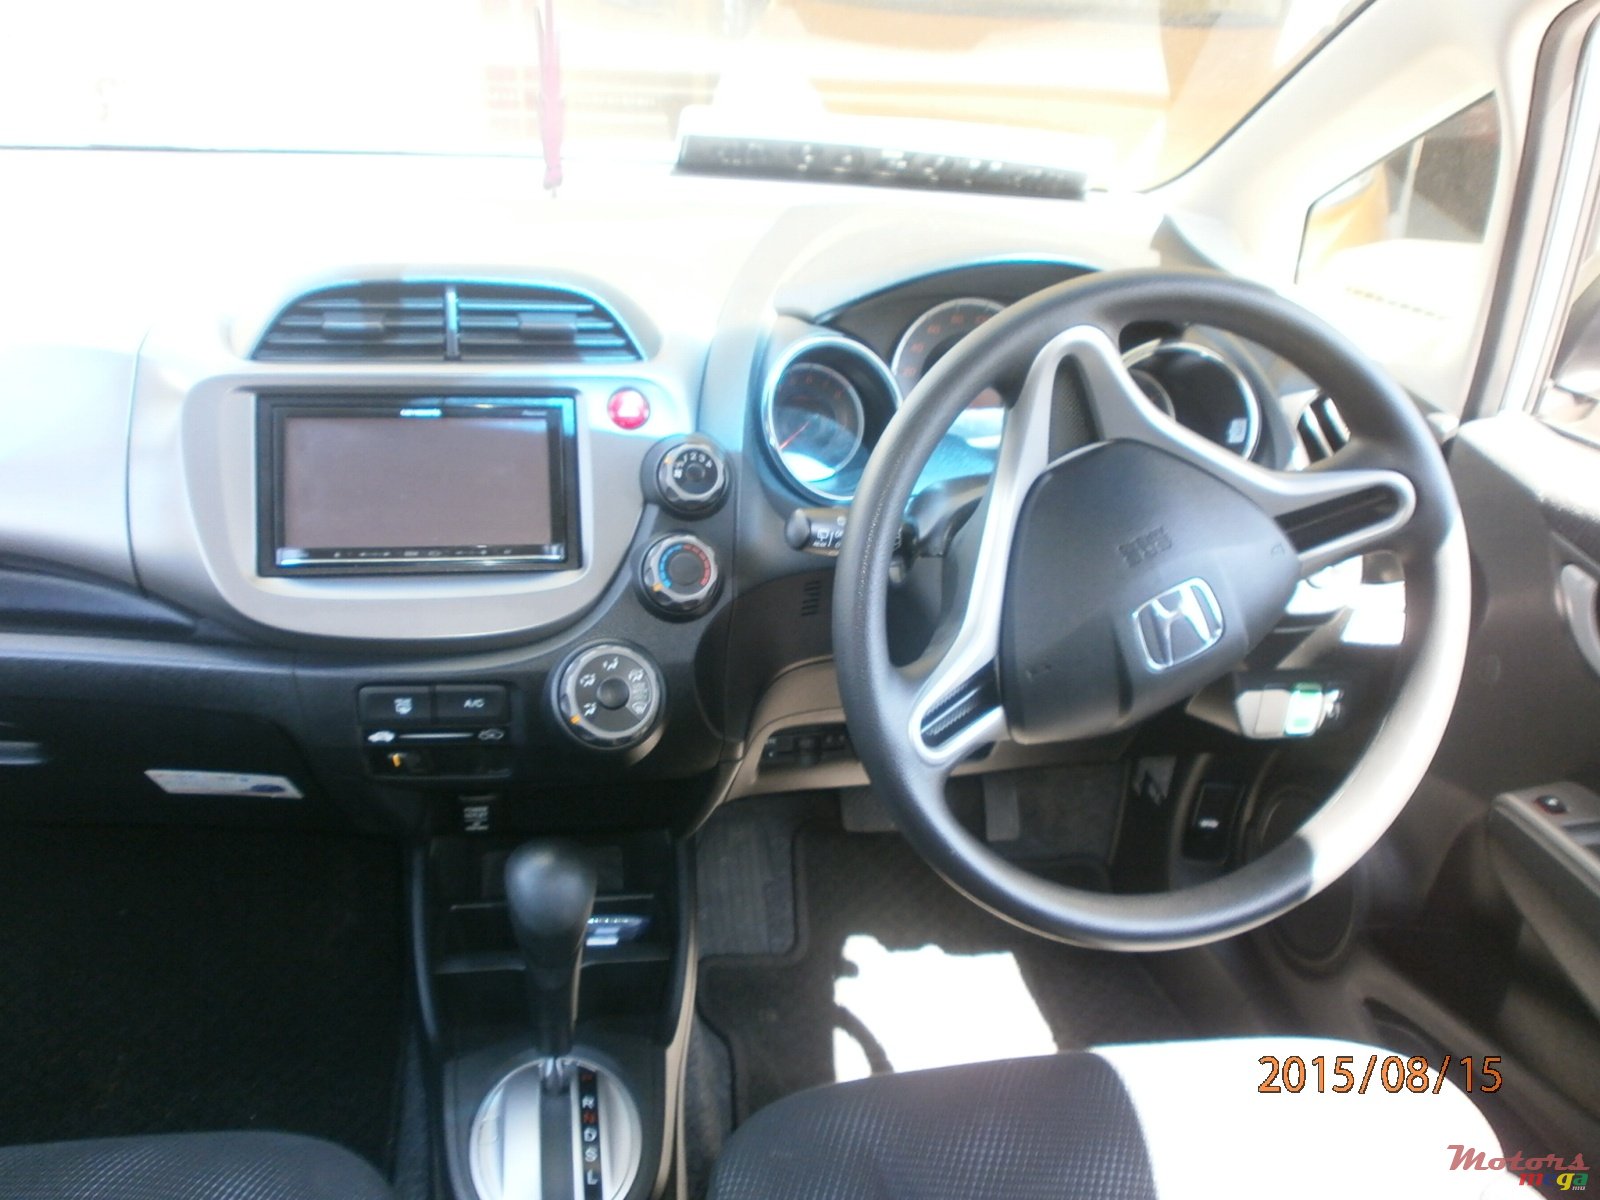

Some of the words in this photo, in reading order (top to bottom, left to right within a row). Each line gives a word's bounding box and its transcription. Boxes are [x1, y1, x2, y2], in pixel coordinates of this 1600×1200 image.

[690, 451, 698, 461] 2
[463, 698, 486, 708] A/C
[584, 1127, 597, 1142] D
[585, 1146, 598, 1162] S
[587, 1168, 598, 1185] L
